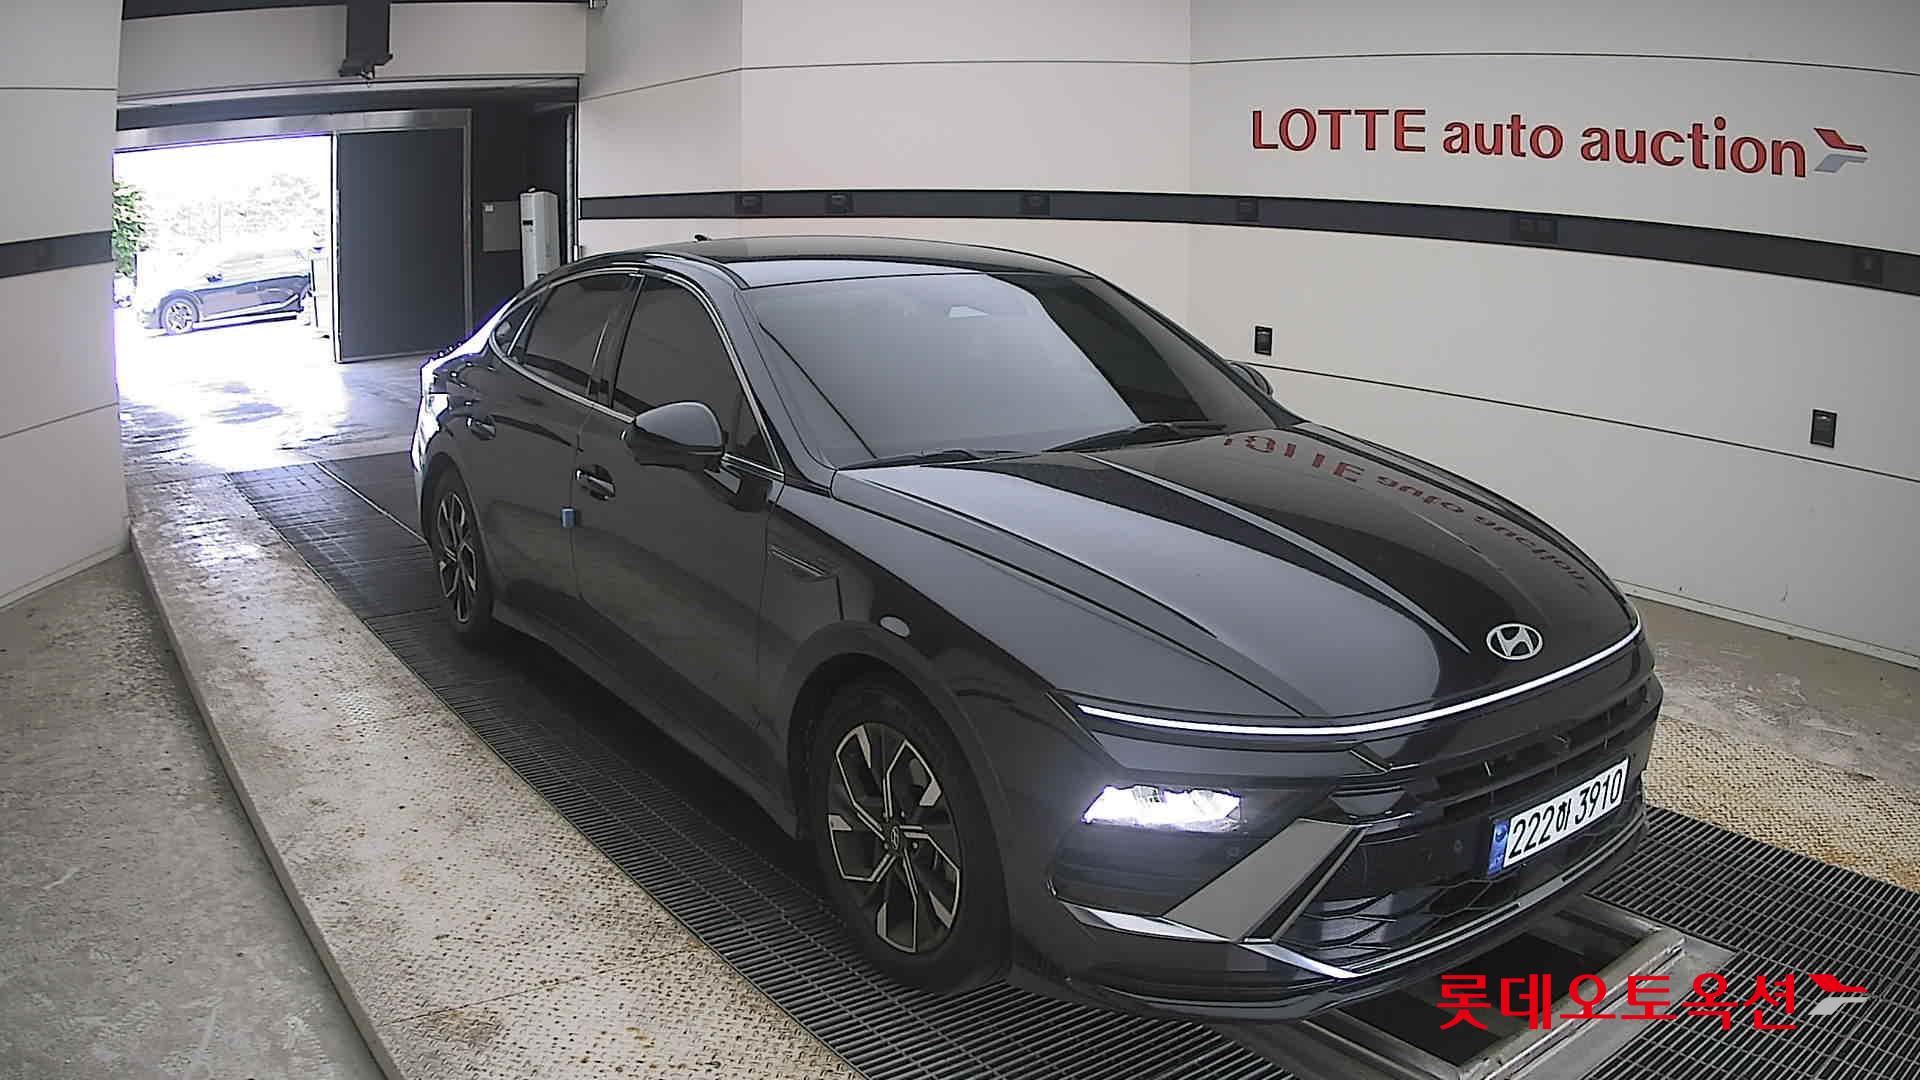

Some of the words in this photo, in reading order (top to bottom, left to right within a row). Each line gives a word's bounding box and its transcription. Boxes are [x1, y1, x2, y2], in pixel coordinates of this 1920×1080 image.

[1252, 108, 1426, 152] LOTTE
[1442, 114, 1564, 160] auto
[1579, 116, 1807, 178] auction
[1508, 798, 1572, 859] 222하
[1575, 768, 1623, 825] 3910
